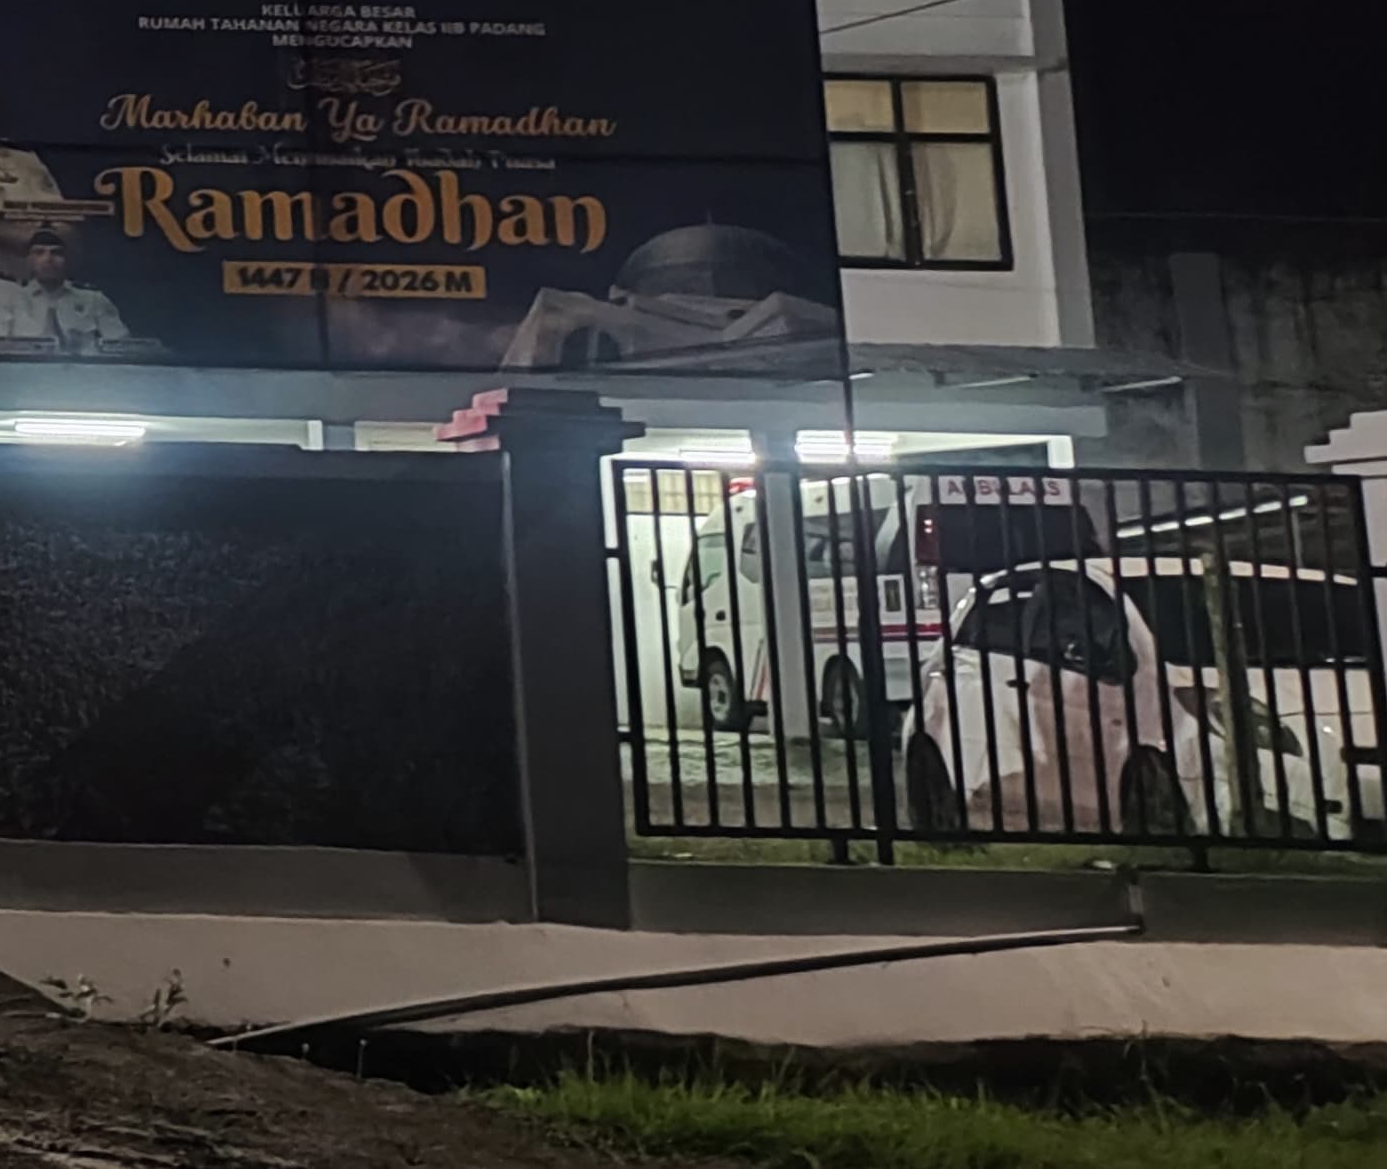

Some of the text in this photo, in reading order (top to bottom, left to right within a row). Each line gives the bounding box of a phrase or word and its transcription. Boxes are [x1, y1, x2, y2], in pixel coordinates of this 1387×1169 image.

[360, 5, 416, 19] BESAR
[138, 16, 205, 30] RUMAH
[209, 17, 300, 32] TAHANAN
[304, 19, 378, 33] NEGARA
[382, 20, 437, 34] KELAS
[469, 22, 546, 36] PADANG
[99, 93, 617, 142] Marhaban Ya Ramadhan
[93, 166, 607, 253] Ramadhan
[238, 267, 300, 289] 1447
[363, 269, 442, 292] 2026
[445, 271, 473, 292] M
